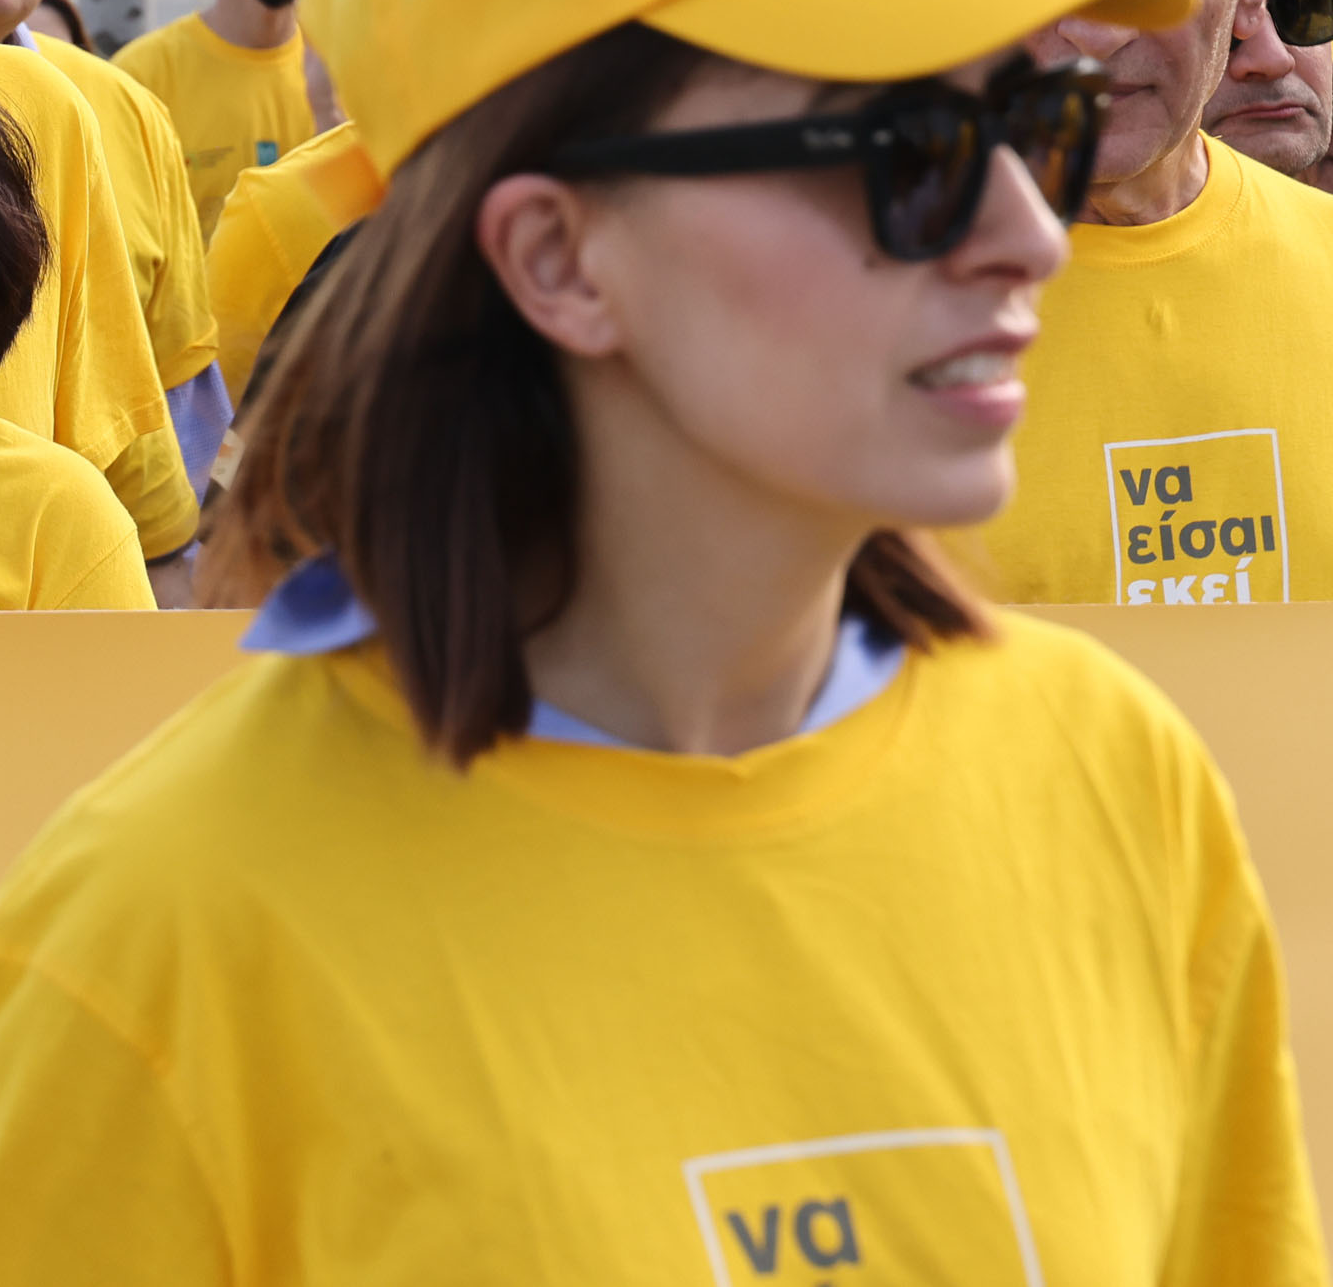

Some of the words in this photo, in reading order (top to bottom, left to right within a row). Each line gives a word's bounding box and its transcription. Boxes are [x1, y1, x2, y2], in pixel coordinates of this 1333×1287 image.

[1119, 466, 1193, 506] να
[1128, 510, 1275, 564] είσαι
[1127, 556, 1254, 605] εκεί
[726, 1196, 861, 1276] να
